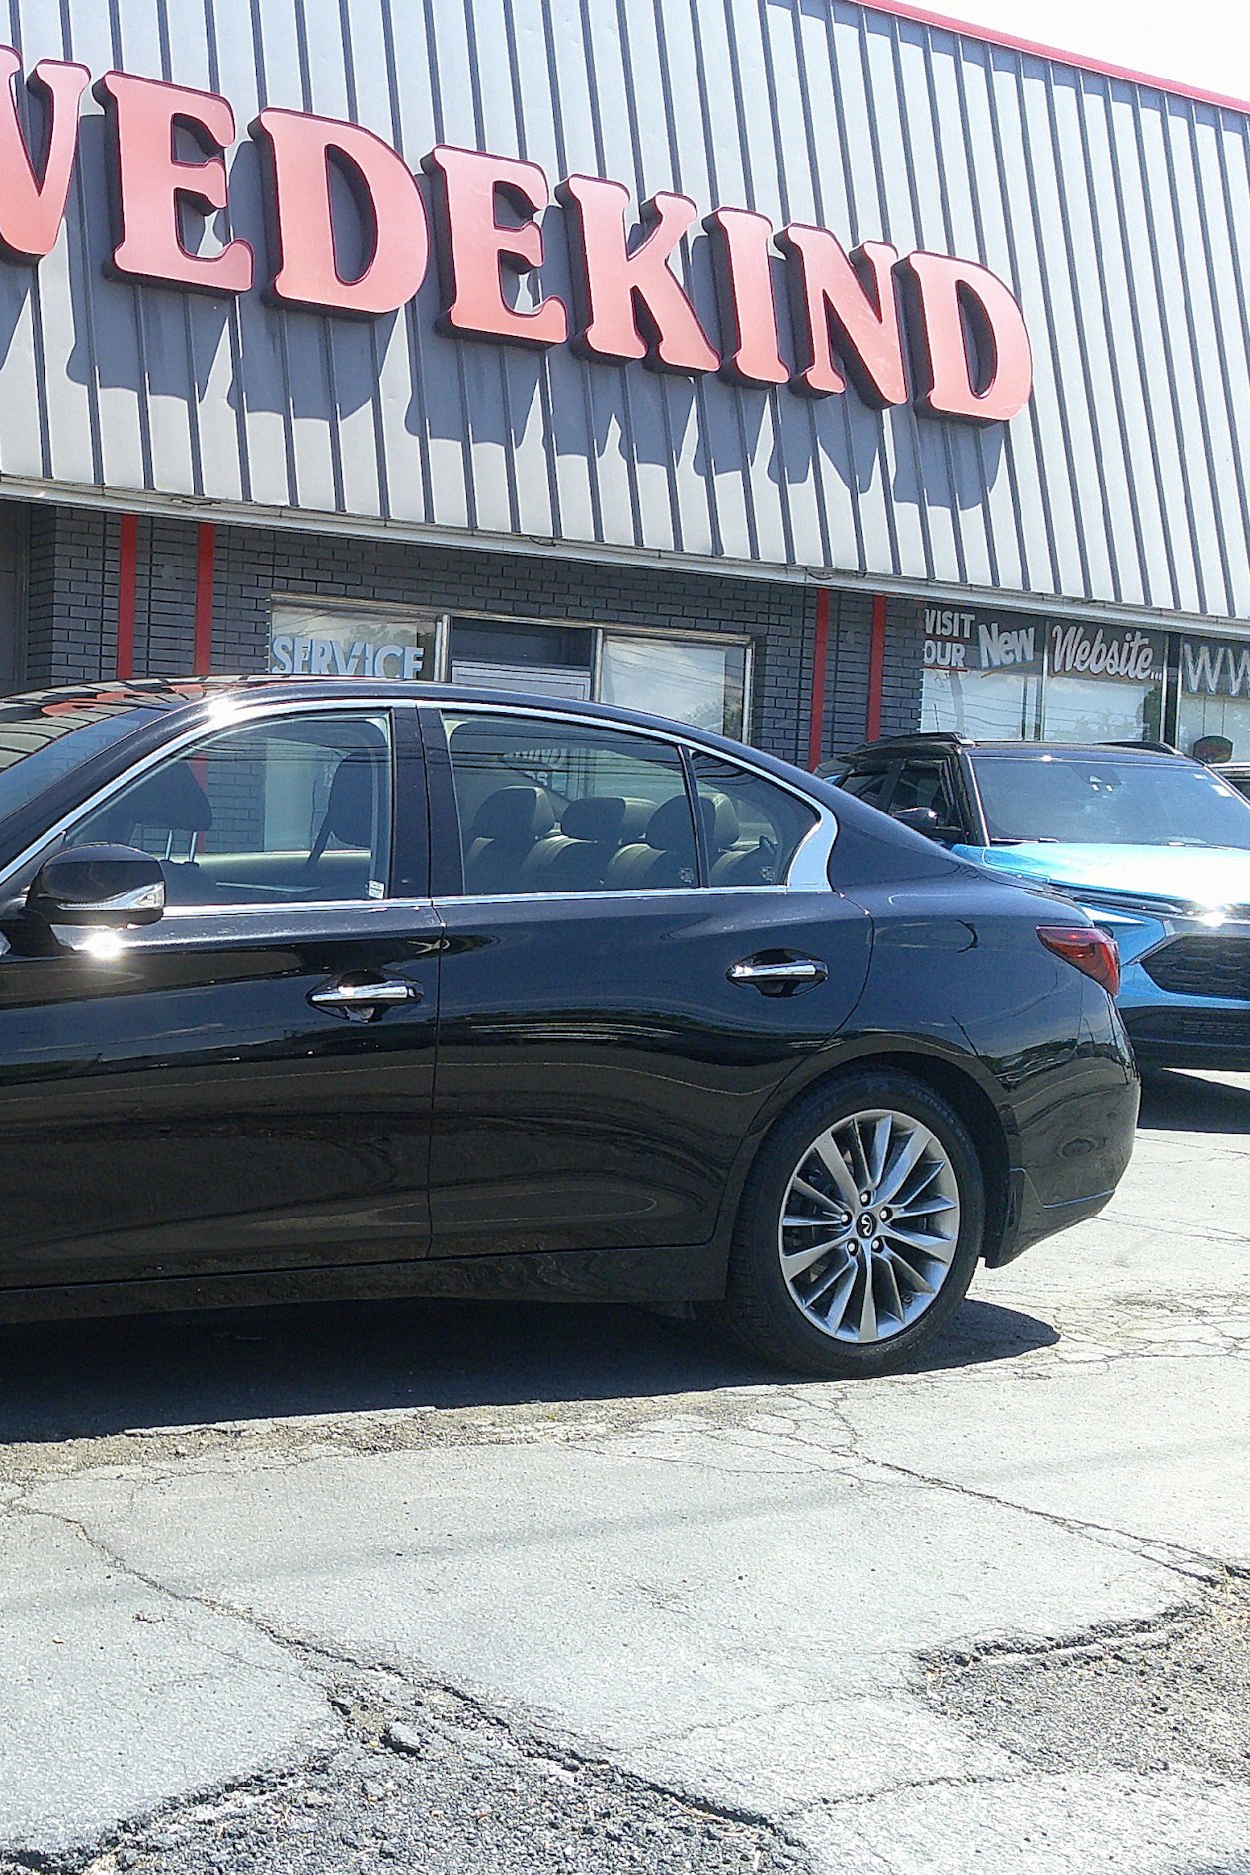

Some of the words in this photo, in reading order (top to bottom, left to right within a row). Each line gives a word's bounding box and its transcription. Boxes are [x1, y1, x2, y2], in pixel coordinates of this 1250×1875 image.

[923, 608, 976, 639] VISIT
[923, 639, 966, 668] OUR
[977, 622, 1036, 670] New
[271, 635, 425, 680] SERVICE
